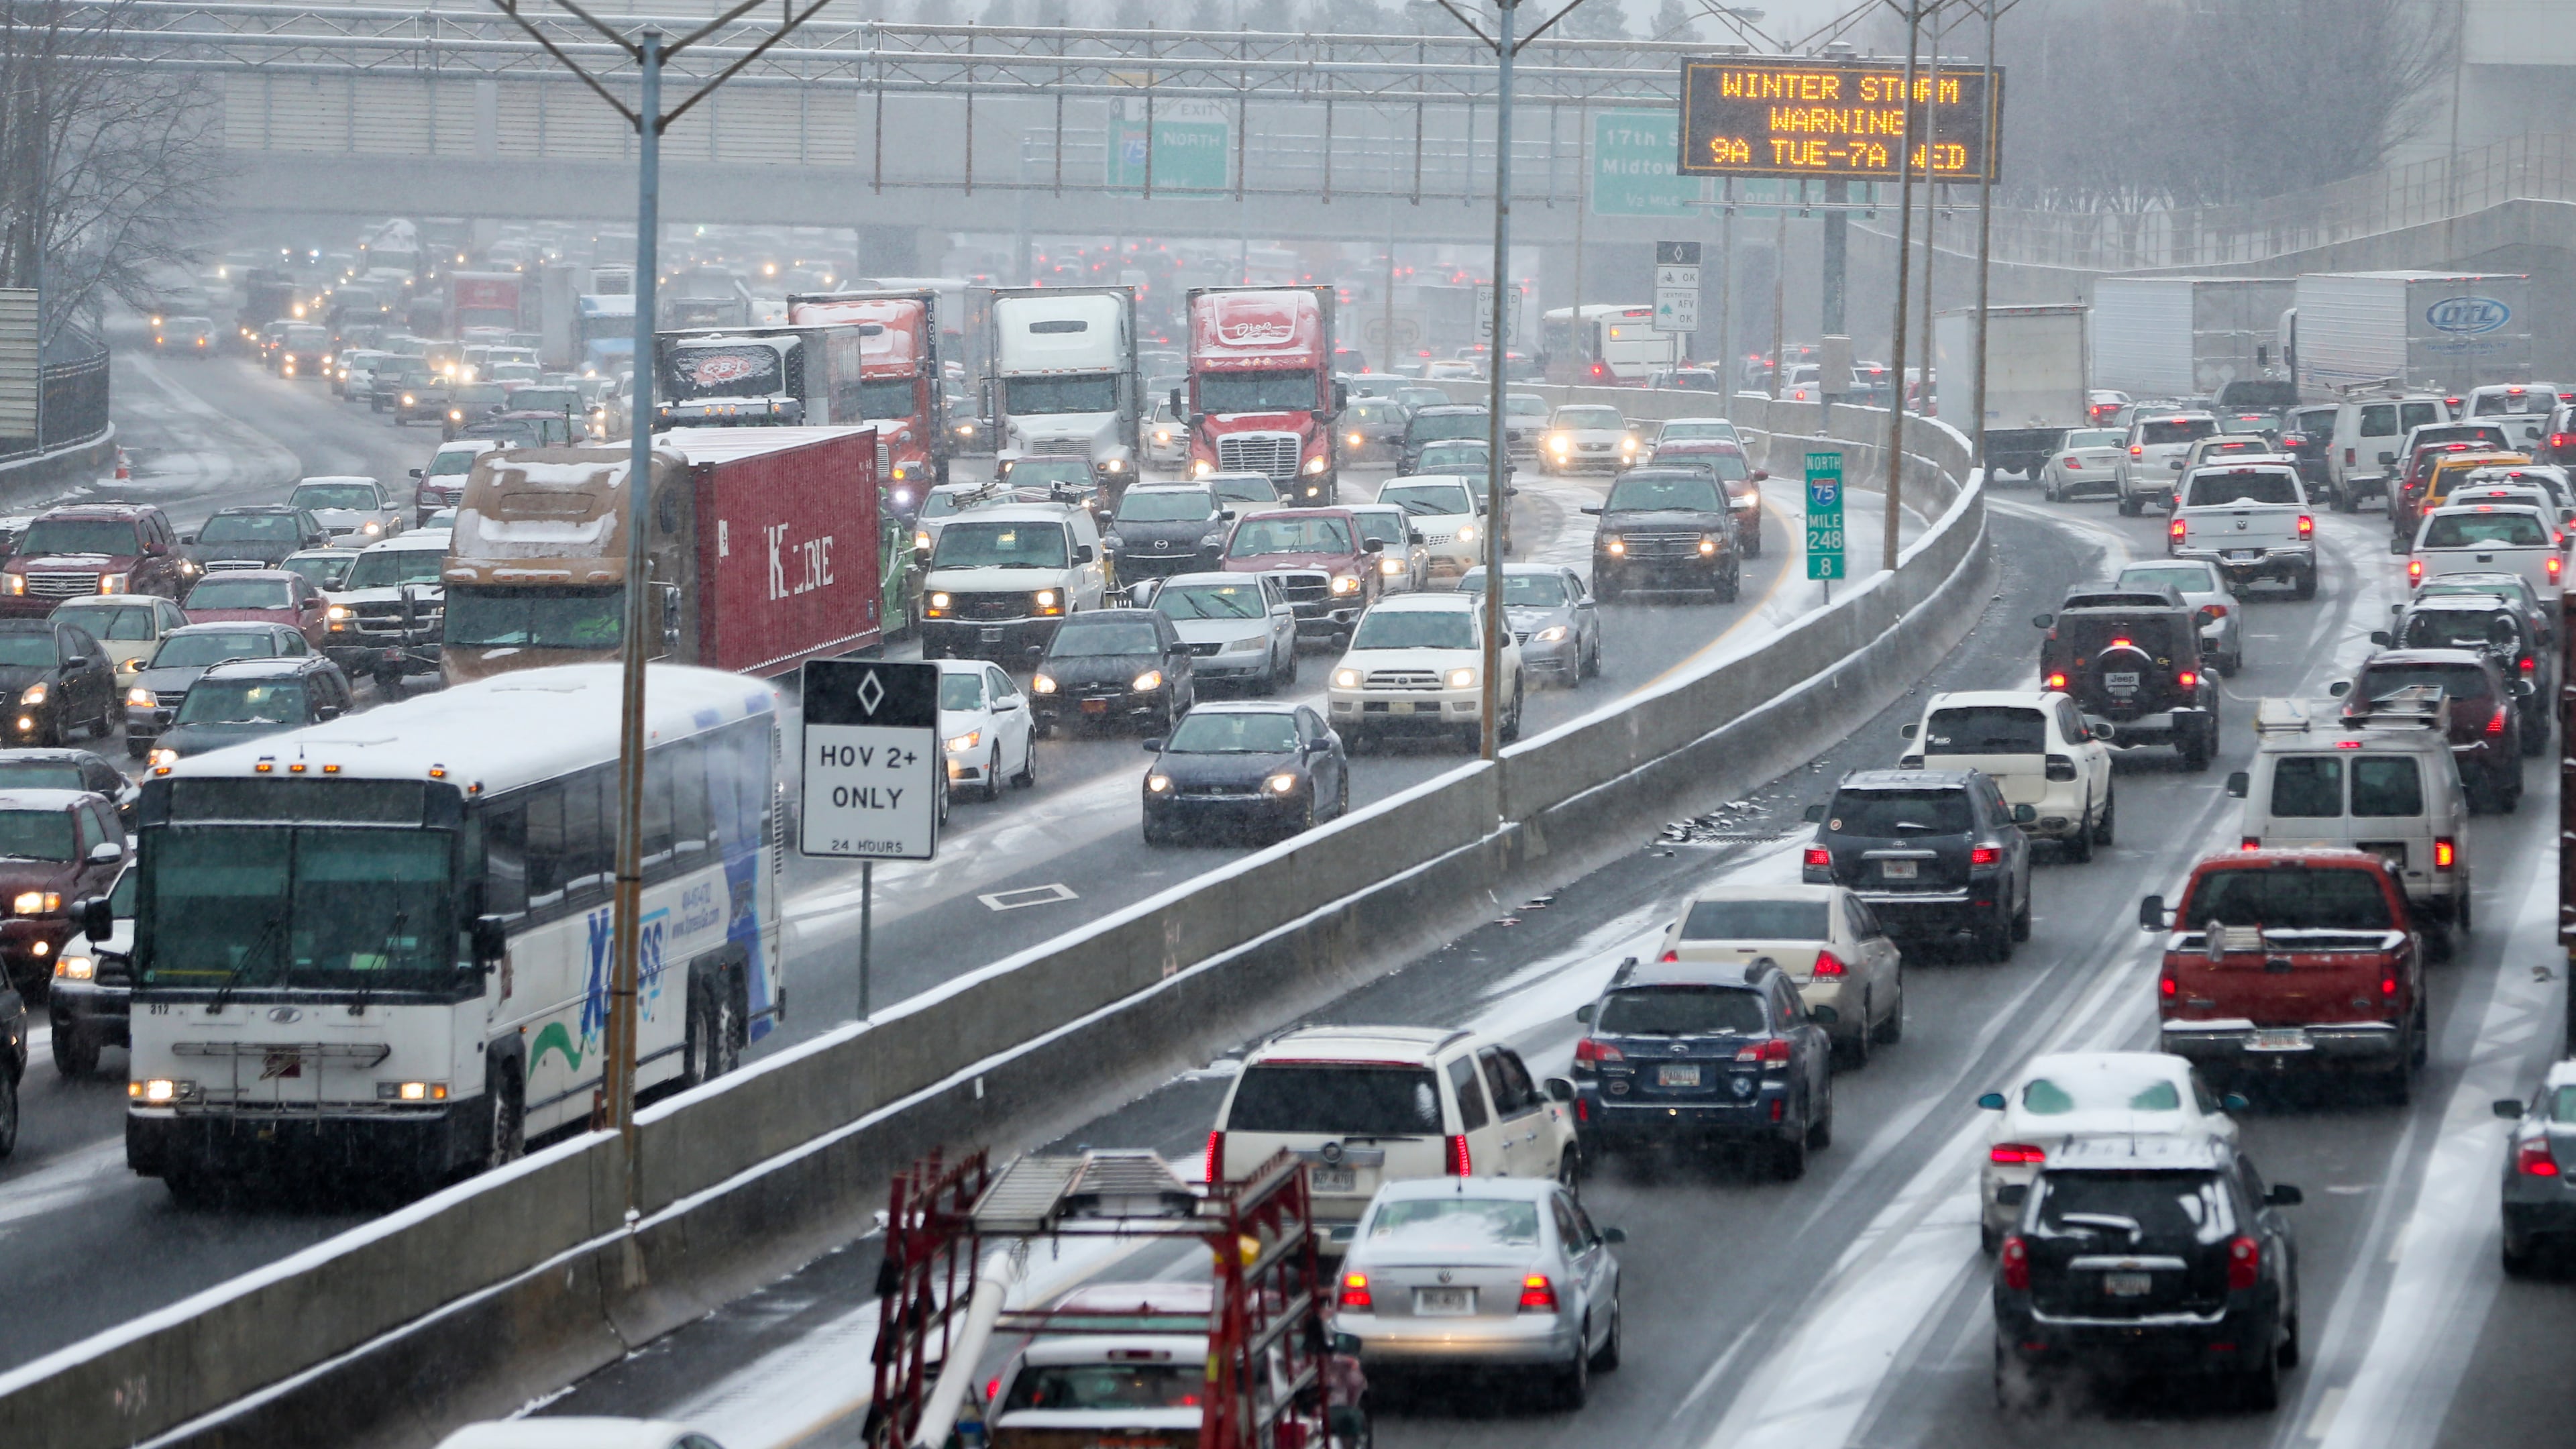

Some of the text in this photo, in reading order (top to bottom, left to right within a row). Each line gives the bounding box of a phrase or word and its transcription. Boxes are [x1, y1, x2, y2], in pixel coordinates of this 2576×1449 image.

[1722, 72, 1959, 104] WINTER STORM
[1138, 103, 1215, 116] HOV EXIT
[1163, 132, 1220, 146] NORTH
[1607, 129, 1678, 146] 17th S
[1126, 140, 1147, 158] 75
[1710, 138, 1750, 164] 9A
[1770, 139, 1887, 168] TUE-7A
[1602, 158, 1678, 174] Midtow
[1650, 195, 1679, 206] MILE
[1682, 273, 1696, 282] OK
[1479, 292, 1517, 303] SPD
[1678, 300, 1695, 309] AFV
[927, 301, 936, 345] 1003
[1679, 314, 1692, 323] OK
[1807, 455, 1841, 470] NORTH
[1813, 485, 1835, 500] 75
[1809, 514, 1841, 528] MILE
[1809, 531, 1841, 549] 248
[2111, 675, 2135, 684] Jeep
[820, 745, 918, 769] HOV 2+
[833, 786, 904, 810] ONLY
[831, 840, 904, 853] 24 HOURS
